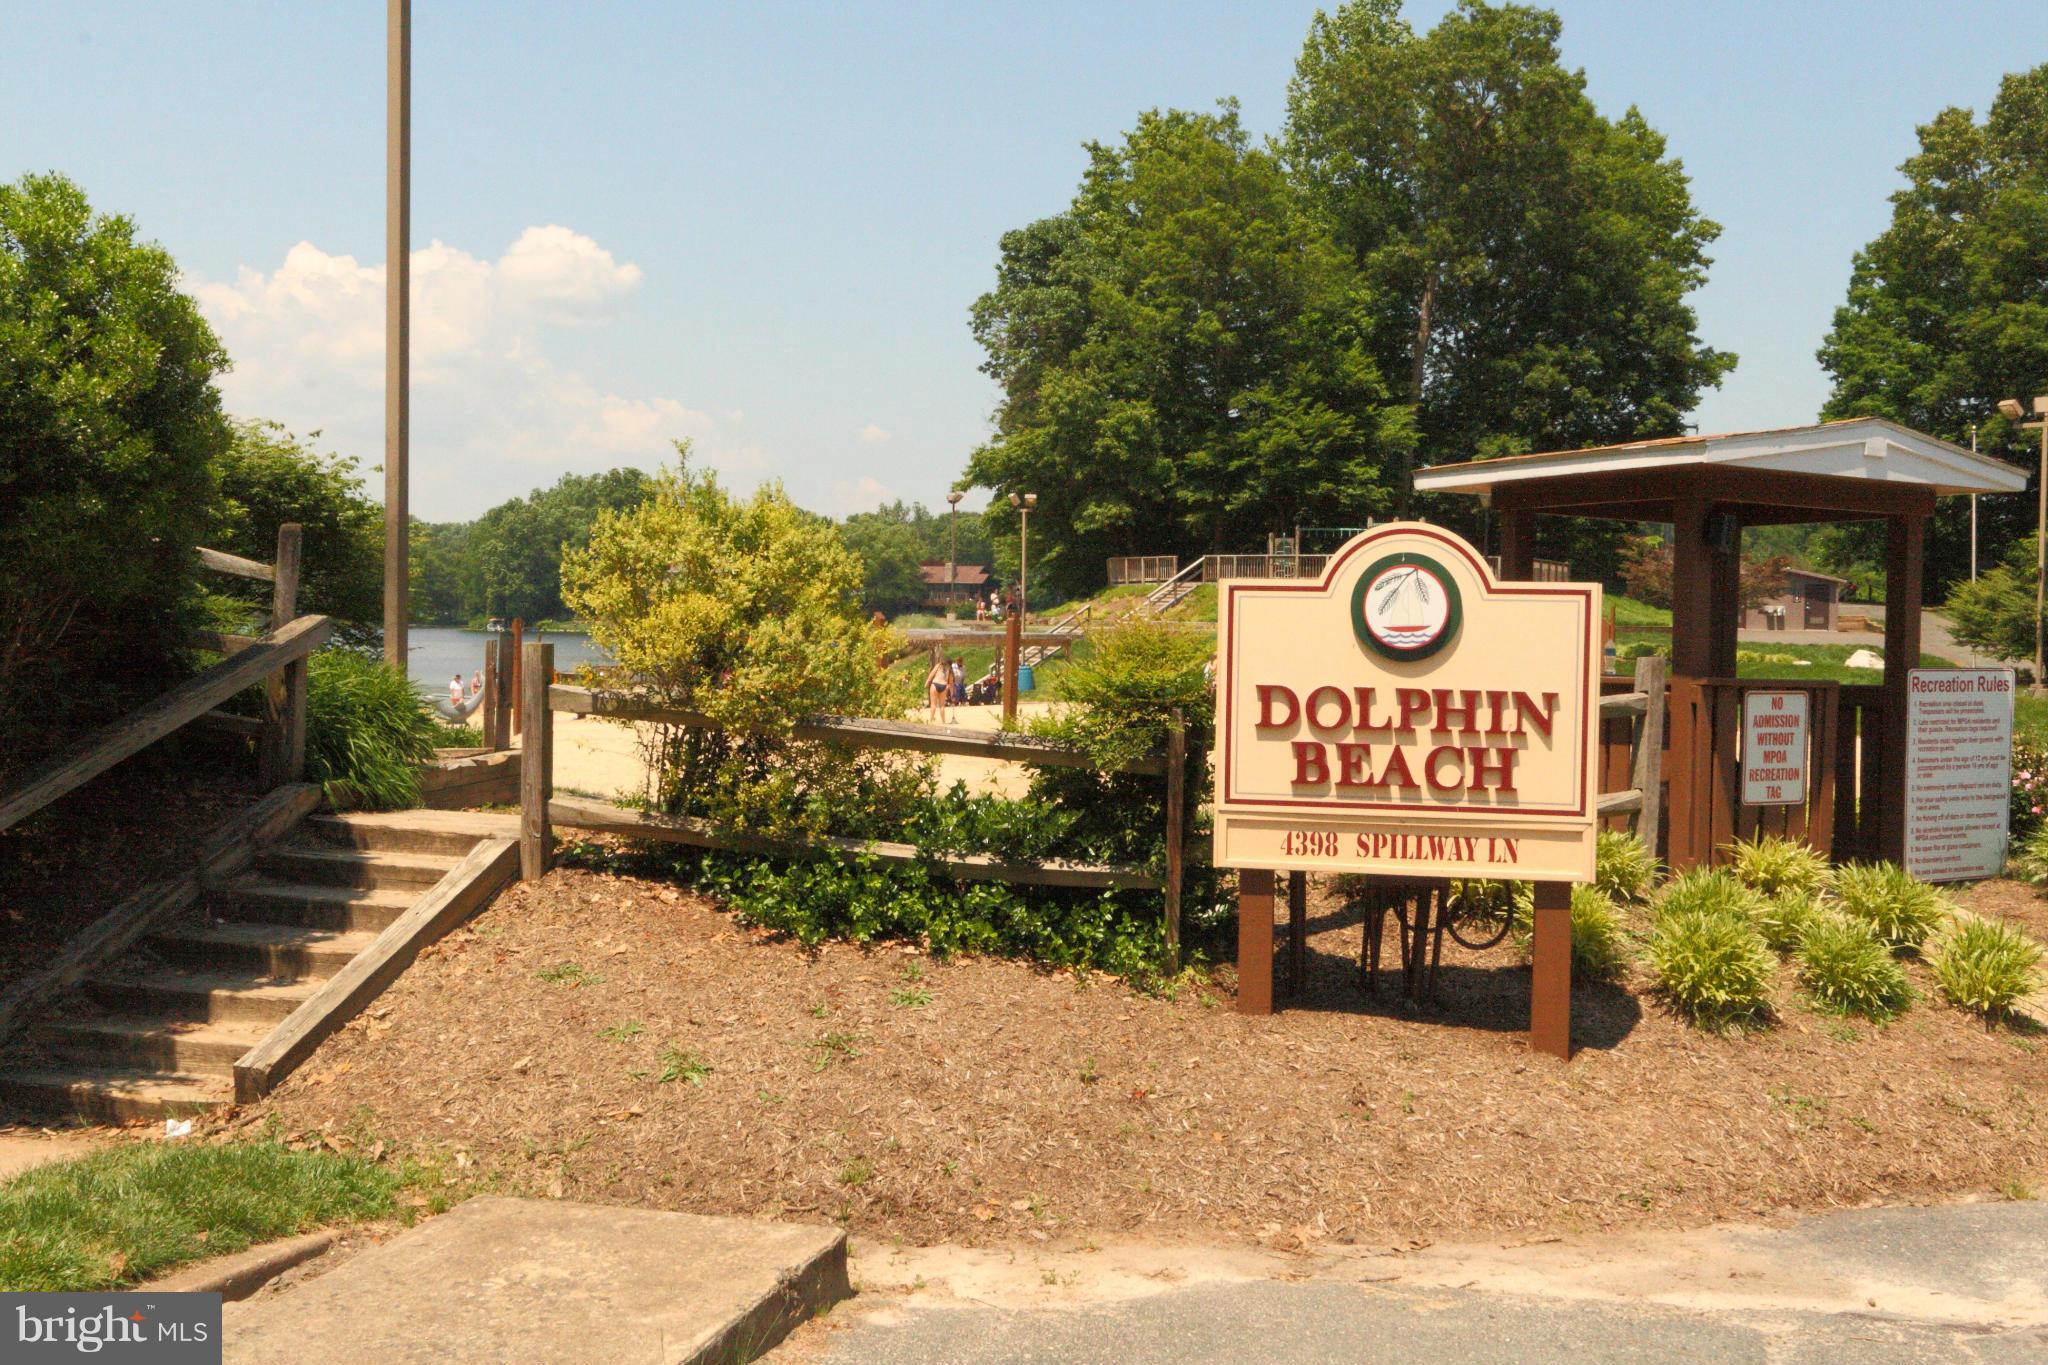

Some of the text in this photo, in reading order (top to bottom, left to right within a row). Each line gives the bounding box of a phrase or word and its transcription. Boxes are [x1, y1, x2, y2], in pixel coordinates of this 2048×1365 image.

[1911, 675, 2010, 693] Recreation Rules
[1255, 684, 1559, 737] DOLPHIN
[1771, 697, 1783, 710] NO
[1753, 714, 1800, 728] ADMISSION
[1757, 732, 1795, 745] WITHOUT
[1763, 750, 1787, 763] MPOA
[1291, 741, 1519, 792] BEACH
[1749, 767, 1800, 782] RECREATION
[1765, 786, 1782, 799] TAG
[1280, 831, 1520, 864] 4398 SPILLWAY LN
